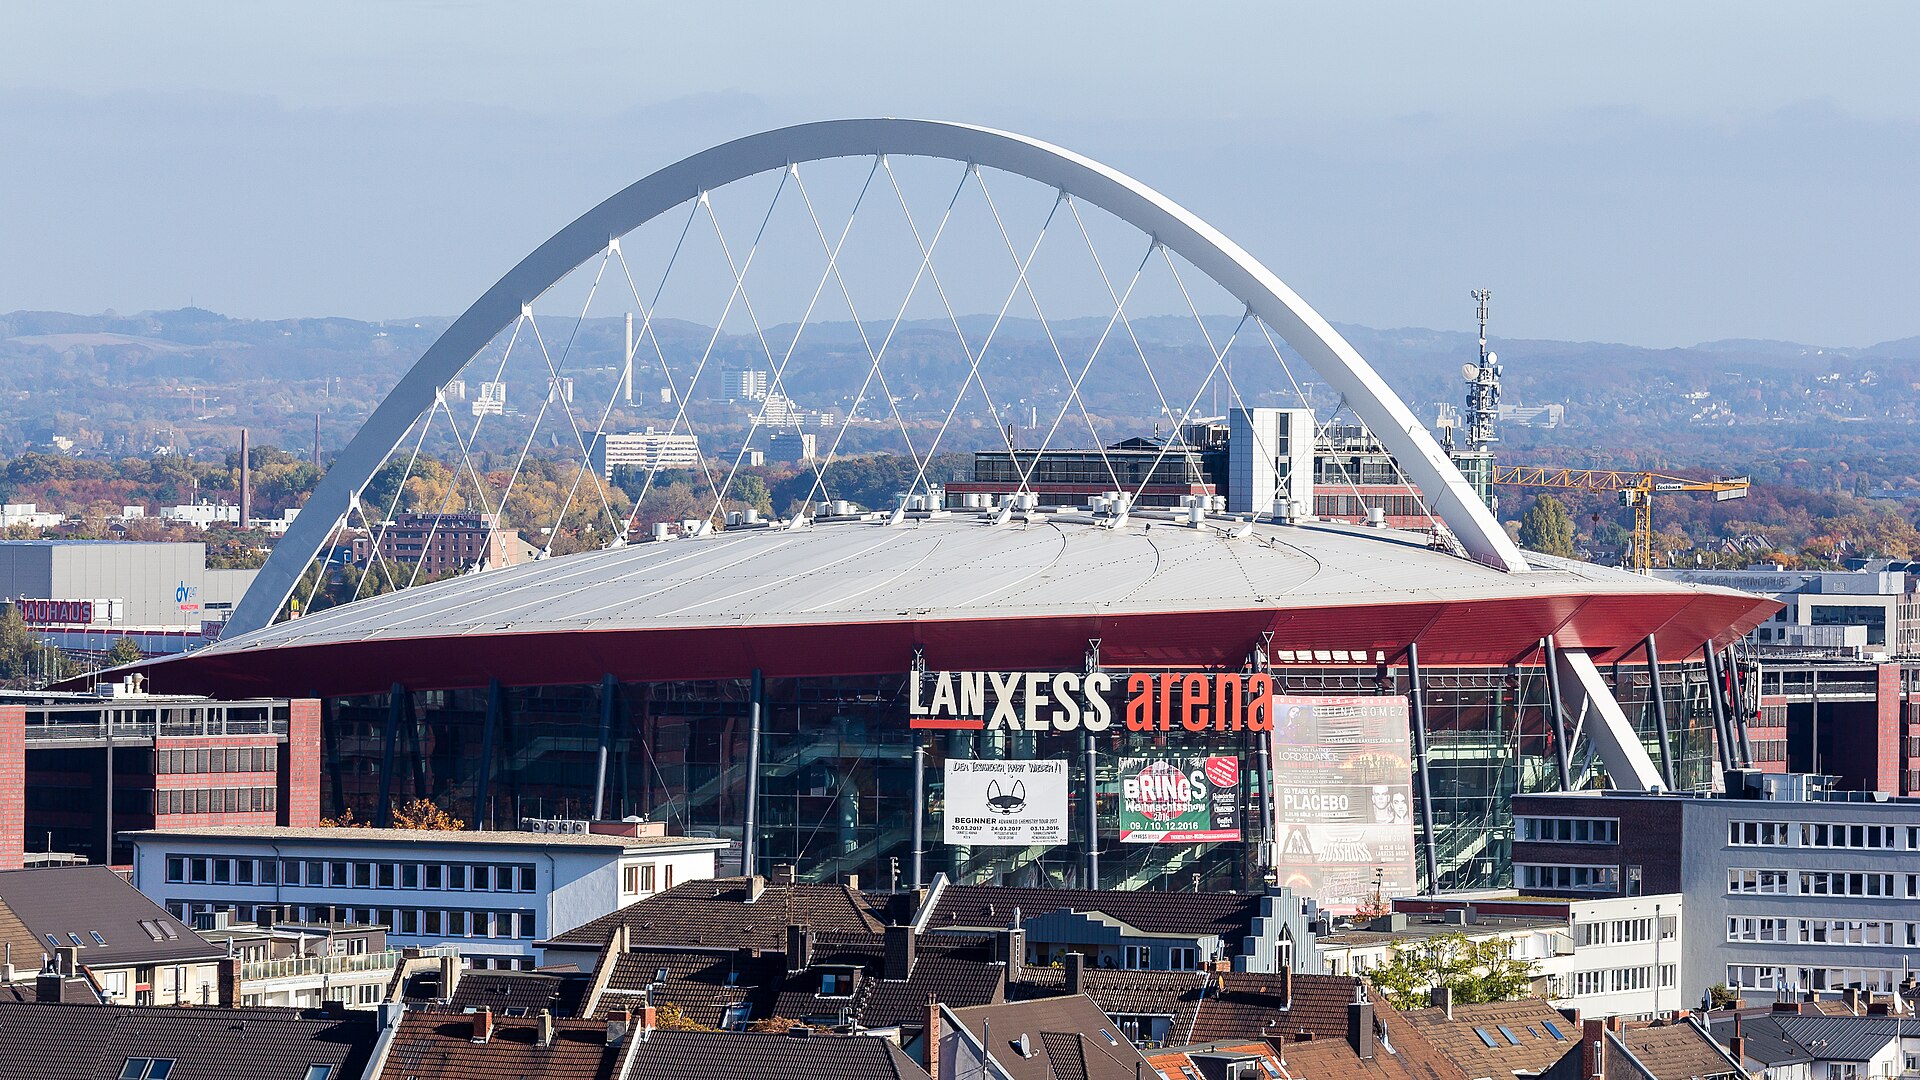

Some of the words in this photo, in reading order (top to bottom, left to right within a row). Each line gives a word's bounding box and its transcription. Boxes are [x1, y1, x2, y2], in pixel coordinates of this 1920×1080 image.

[910, 671, 1112, 732] LANXESS
[1127, 672, 1274, 732] arena
[1361, 706, 1404, 717] GOMEZ
[1123, 770, 1207, 802] BRINGS
[1284, 794, 1349, 810] PLACEBO
[954, 817, 997, 825] BEGINNER
[1130, 821, 1143, 830] 09.
[1151, 821, 1164, 830] 10.
[1165, 821, 1199, 830] 12.2016
[1318, 842, 1373, 862] BOSSHOSS
